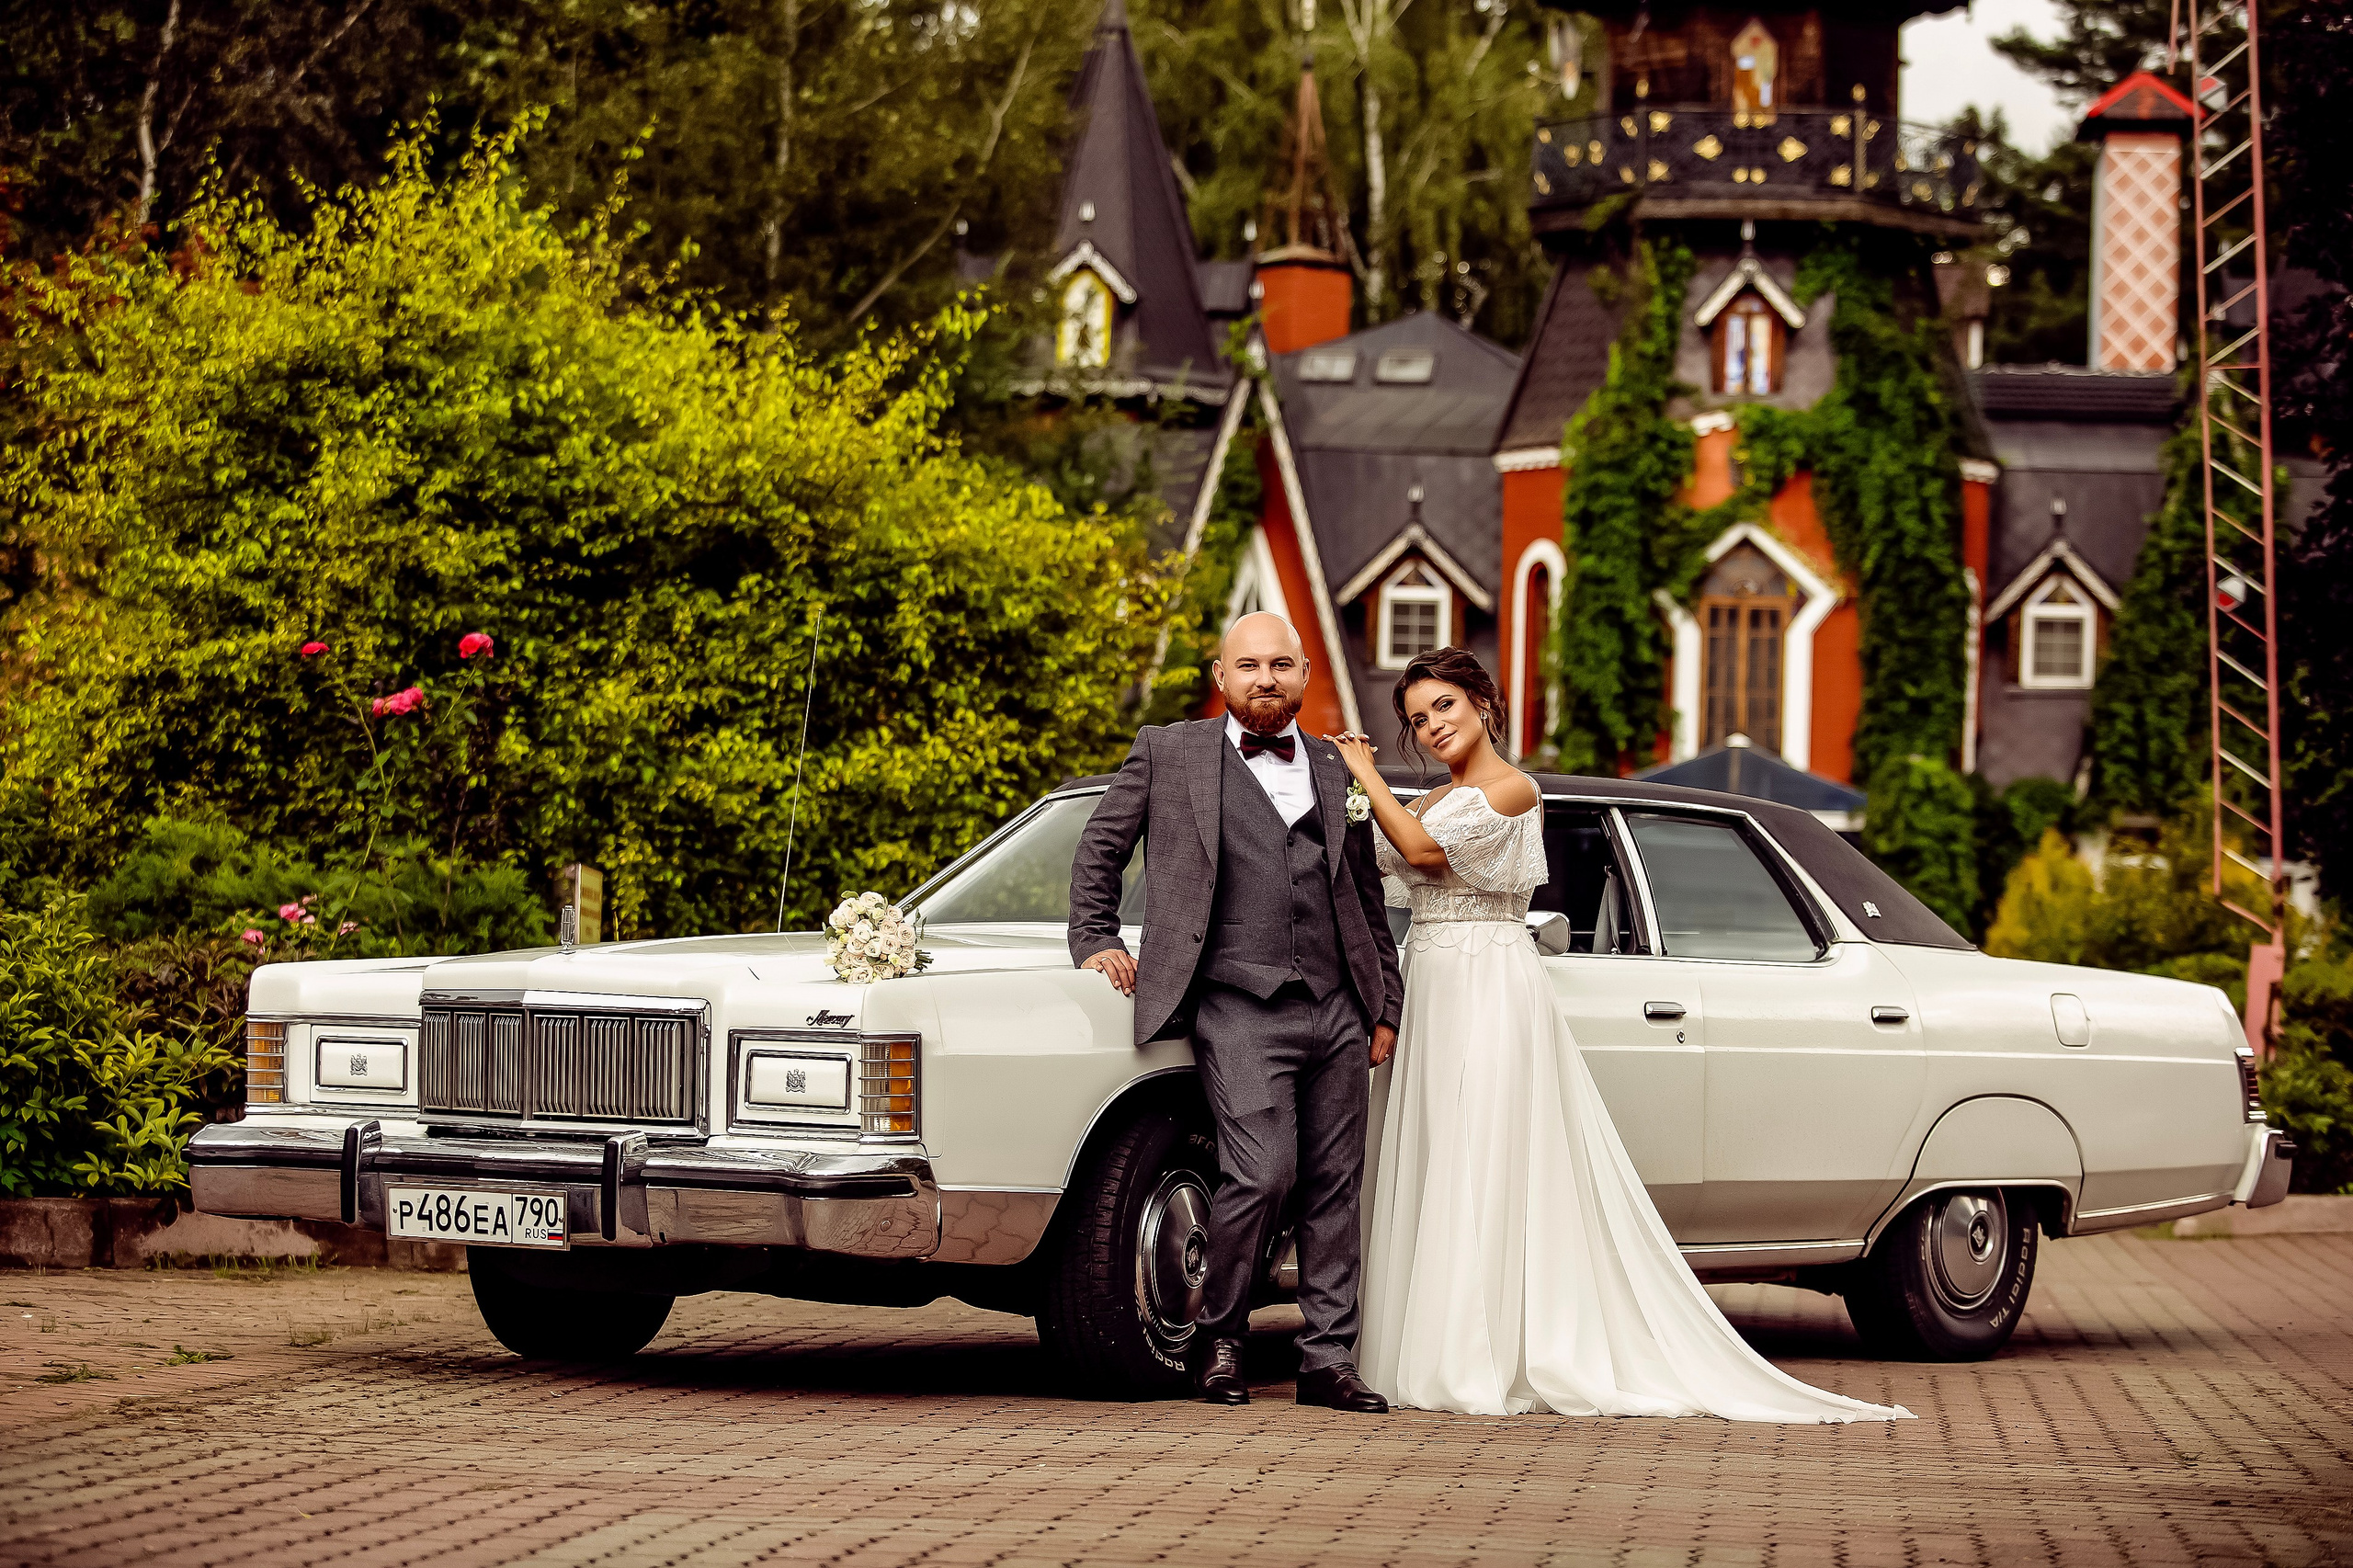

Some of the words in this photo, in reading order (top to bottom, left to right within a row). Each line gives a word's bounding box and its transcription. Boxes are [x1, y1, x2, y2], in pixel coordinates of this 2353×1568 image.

[806, 1009, 855, 1028] Mercury
[399, 1193, 508, 1236] P486EA
[515, 1196, 559, 1228] 790
[525, 1228, 547, 1240] RUS
[2007, 1227, 2030, 1305] Radial
[1989, 1306, 2010, 1328] T/A
